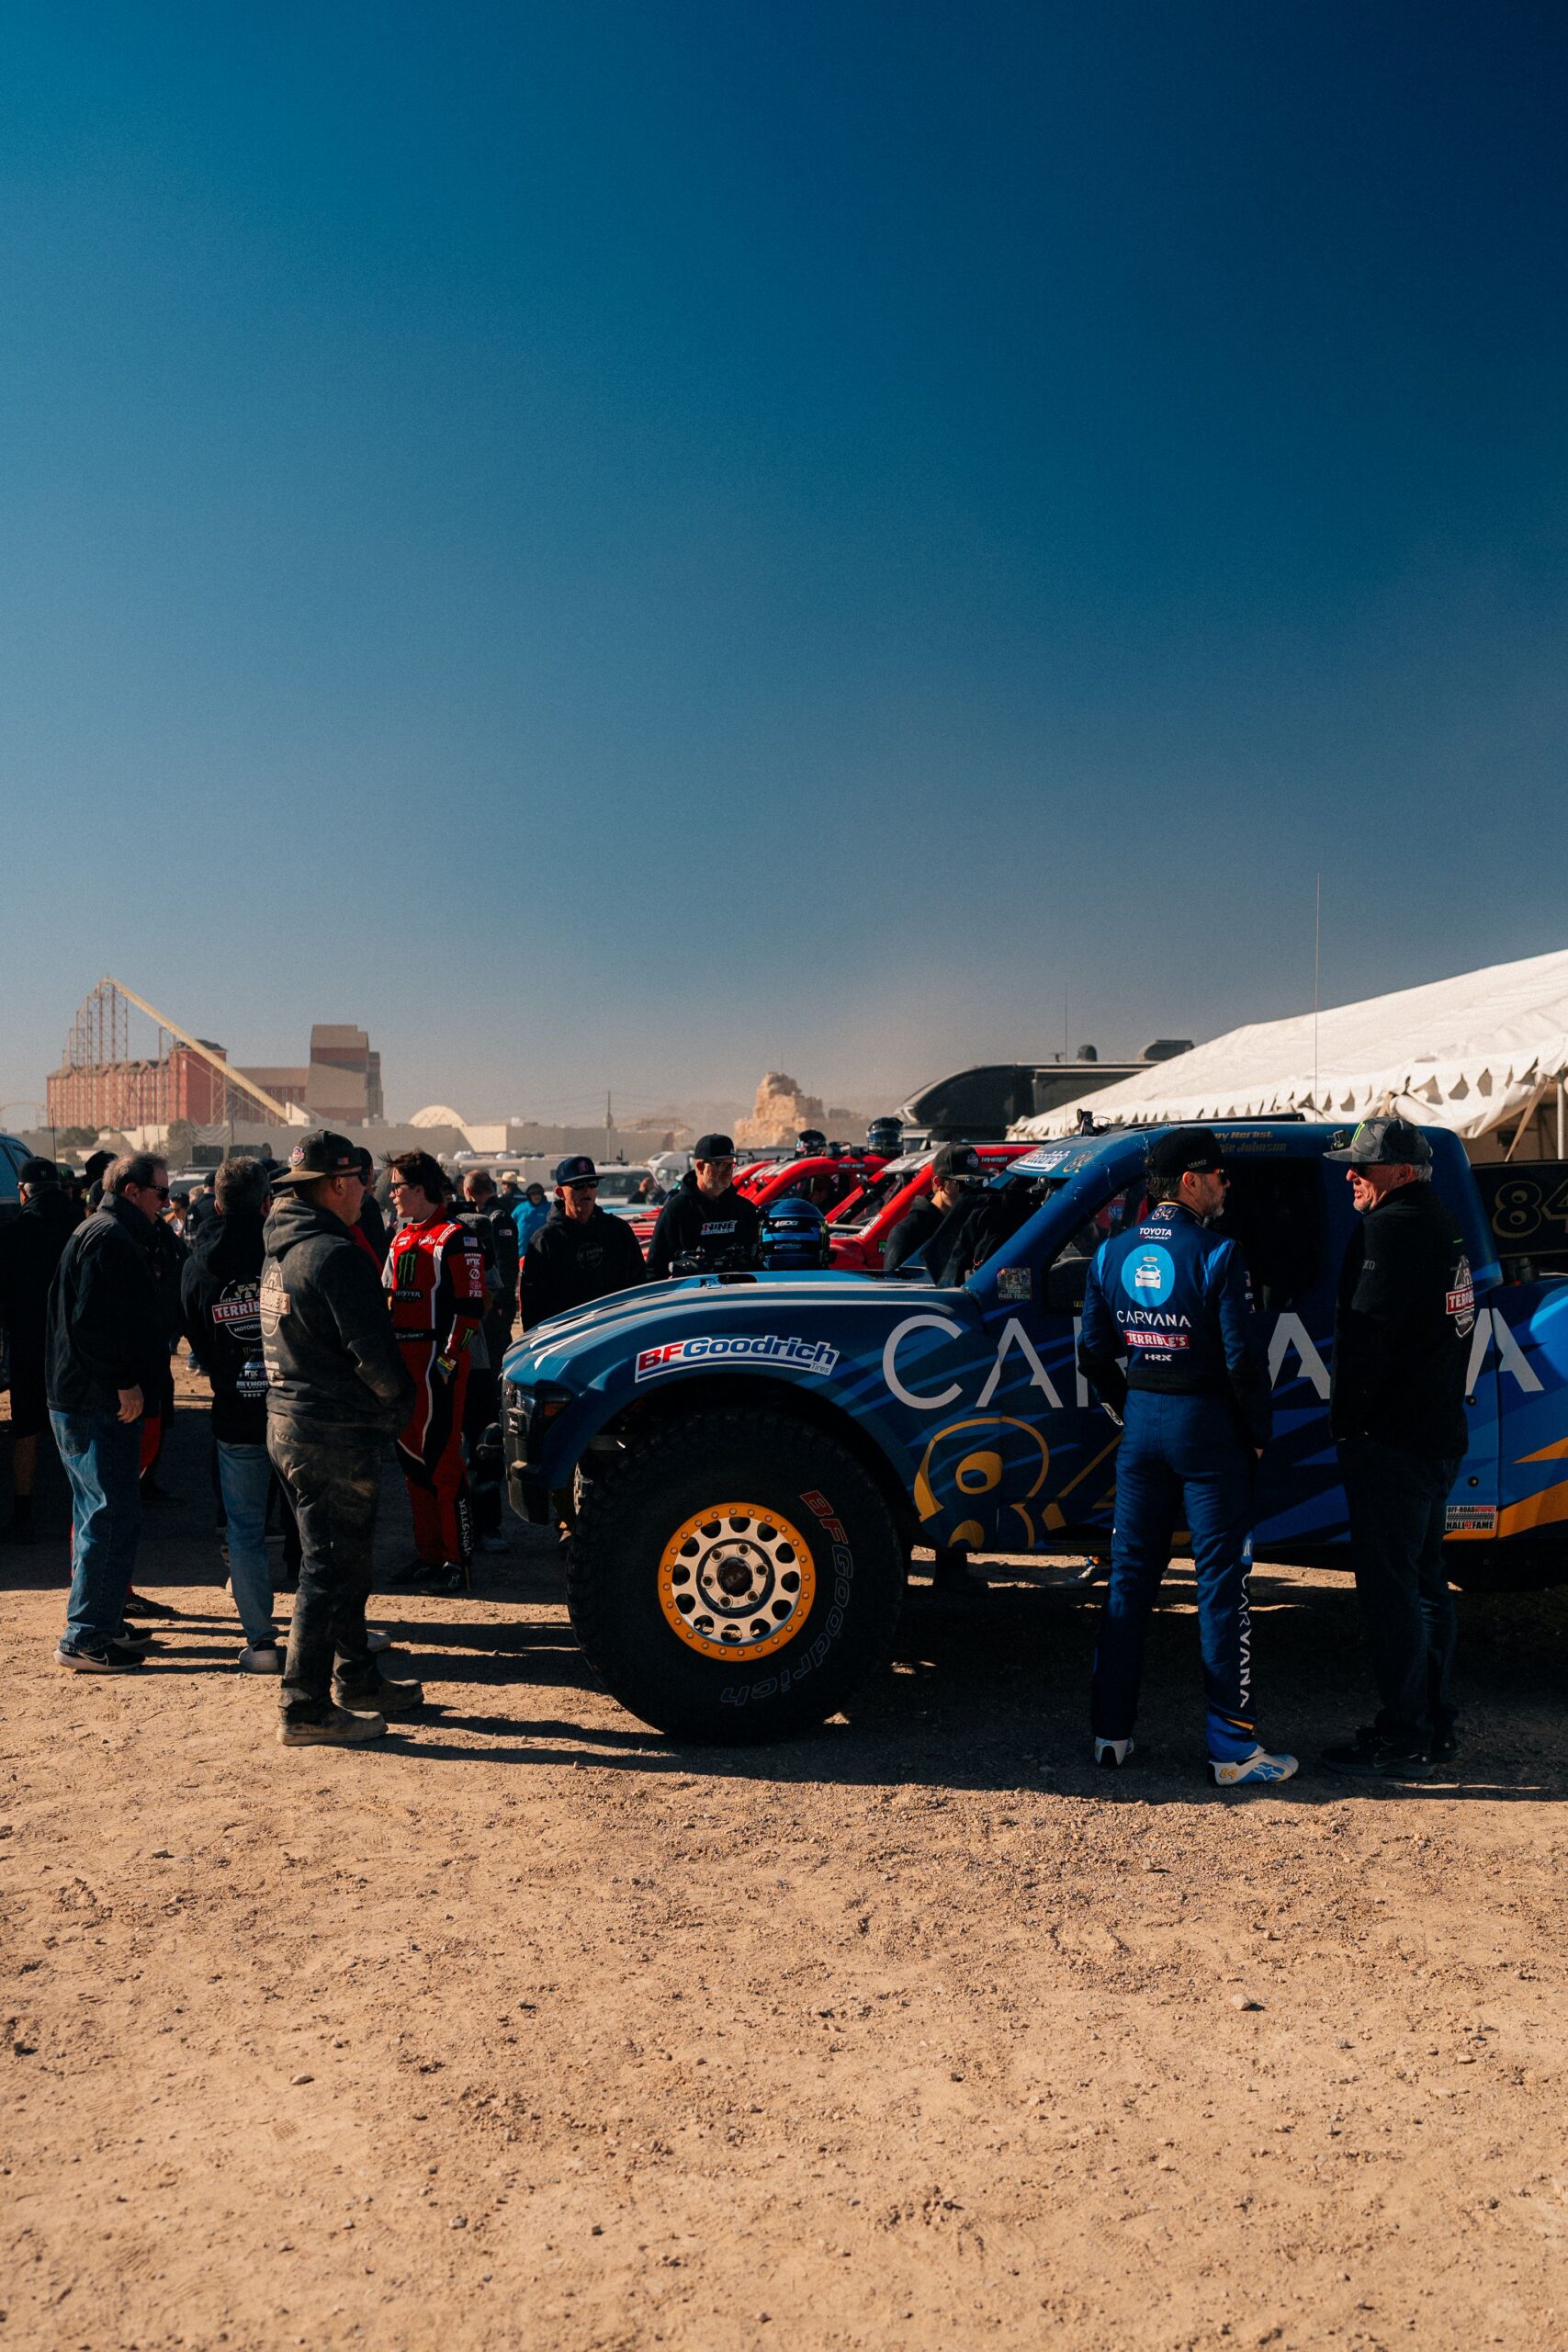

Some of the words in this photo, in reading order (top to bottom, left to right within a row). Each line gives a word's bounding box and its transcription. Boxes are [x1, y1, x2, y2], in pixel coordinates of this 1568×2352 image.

[1152, 1205, 1178, 1221] 84
[1139, 1227, 1172, 1237] TOYOTA
[215, 1301, 261, 1319] TERRIB
[1116, 1310, 1192, 1328] CARVANA
[1126, 1332, 1187, 1348] TERRIBLE'S
[638, 1336, 836, 1372] BFGoodrich
[1145, 1353, 1173, 1363] HRX
[810, 1363, 830, 1374] Tires
[1447, 1521, 1465, 1530] HALL
[1472, 1521, 1495, 1530] FAME
[720, 1488, 854, 1706] BFGoodrich
[1237, 1573, 1252, 1709] CARVANA
[1219, 1768, 1238, 1780] 84
